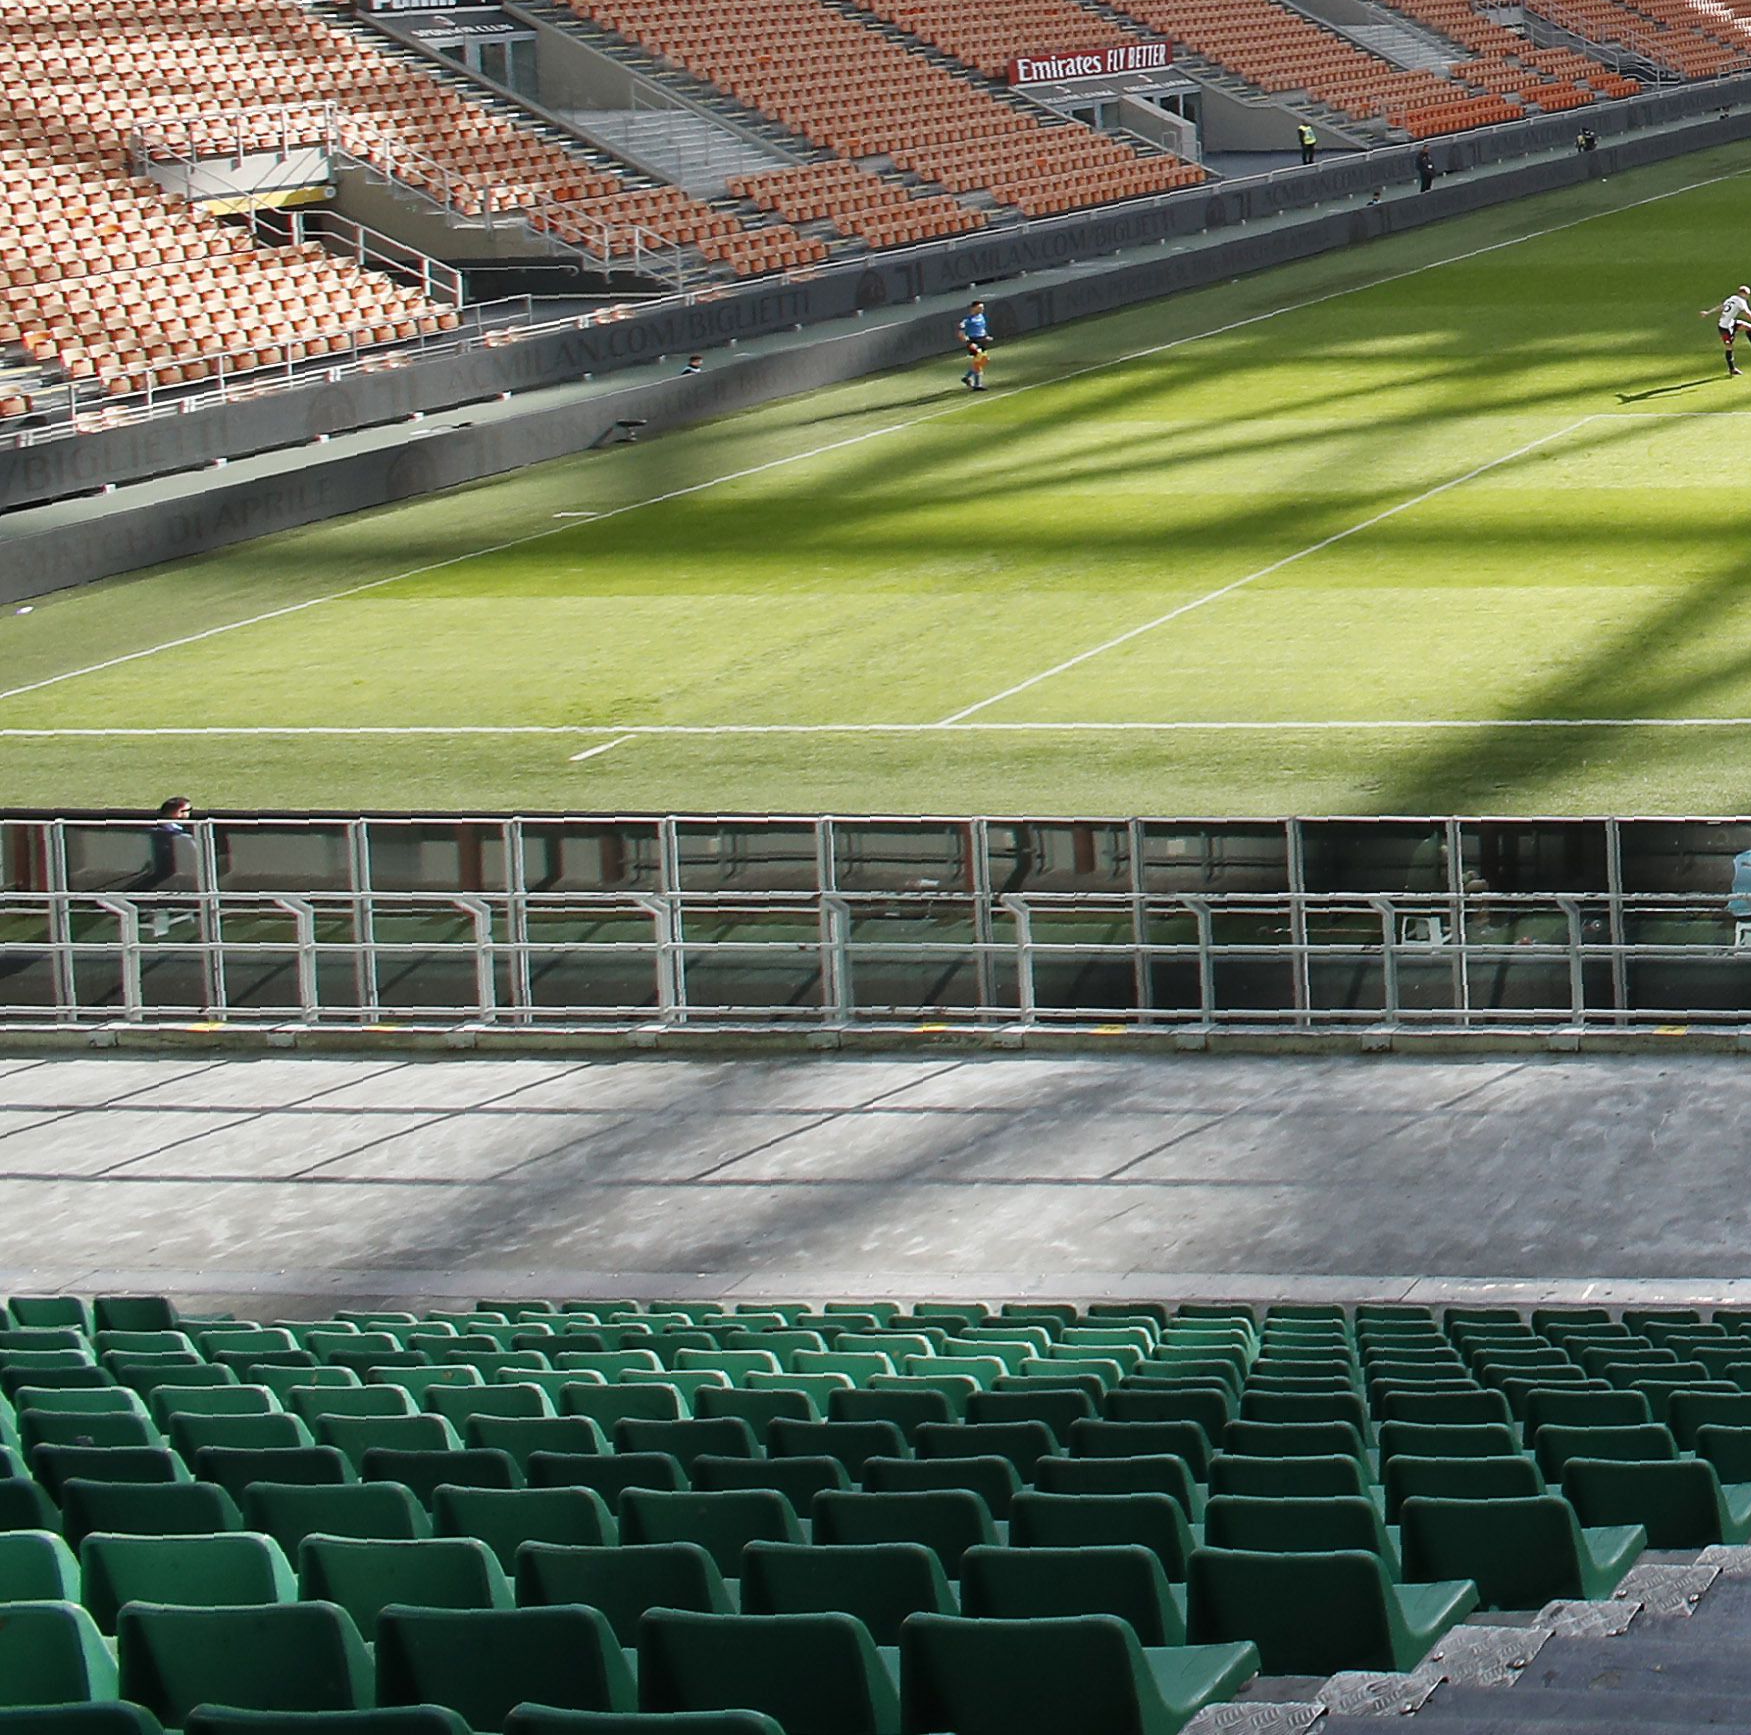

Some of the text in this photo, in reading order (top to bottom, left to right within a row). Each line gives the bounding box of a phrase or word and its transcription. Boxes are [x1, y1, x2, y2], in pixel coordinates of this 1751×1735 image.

[1016, 43, 1167, 82] Emirates FLY BETTER
